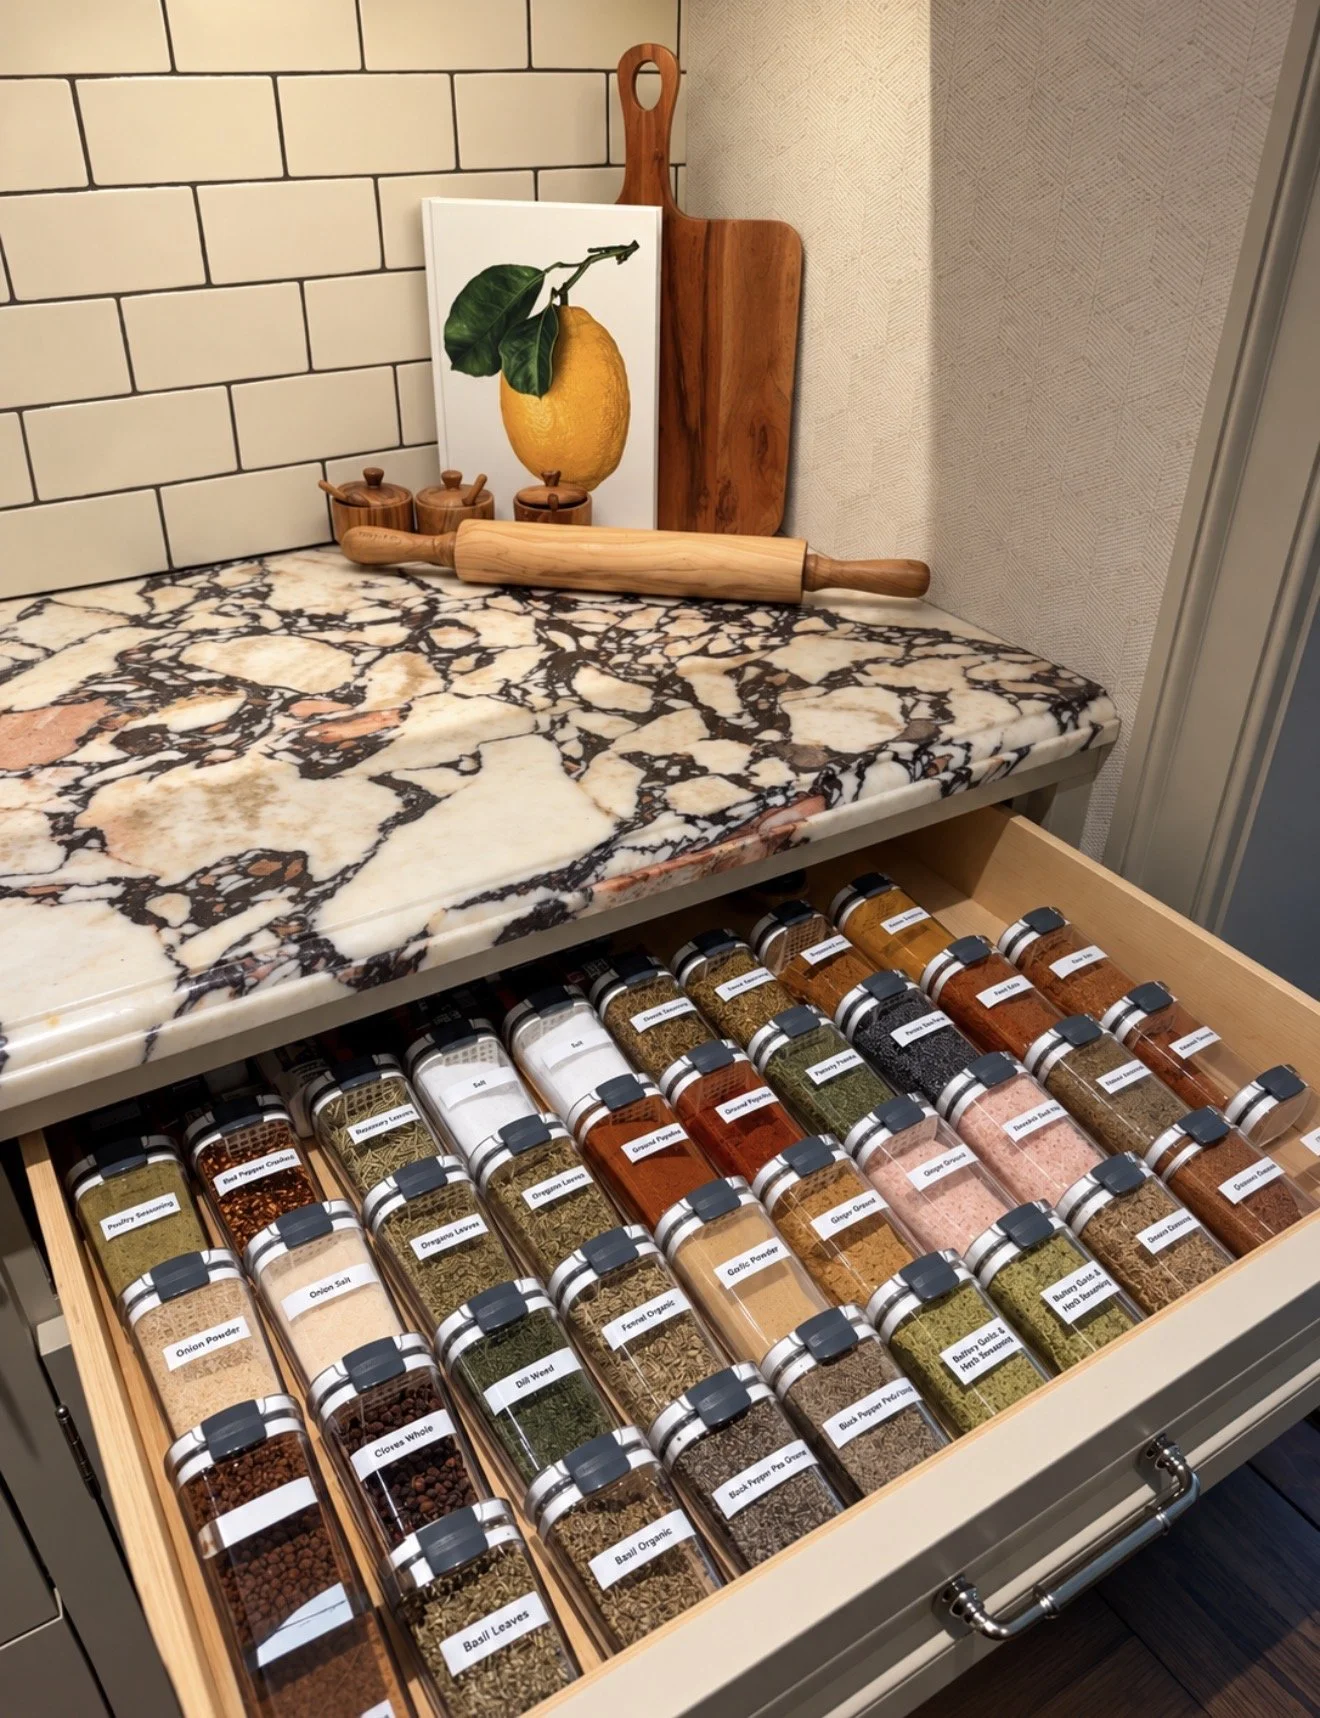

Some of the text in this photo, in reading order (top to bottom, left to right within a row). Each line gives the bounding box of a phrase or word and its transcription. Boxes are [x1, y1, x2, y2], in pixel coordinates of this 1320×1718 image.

[473, 1080, 486, 1089] Salt
[751, 1245, 778, 1264] Powder
[309, 1276, 352, 1299] Onion Salt
[647, 1299, 676, 1318] Organic
[176, 1326, 240, 1358] Onion Powder
[515, 1375, 531, 1389] Dill
[374, 1424, 434, 1458] Cloves Whole
[614, 1527, 673, 1566] Basil Organic
[463, 1609, 530, 1652] Basil Leaves
